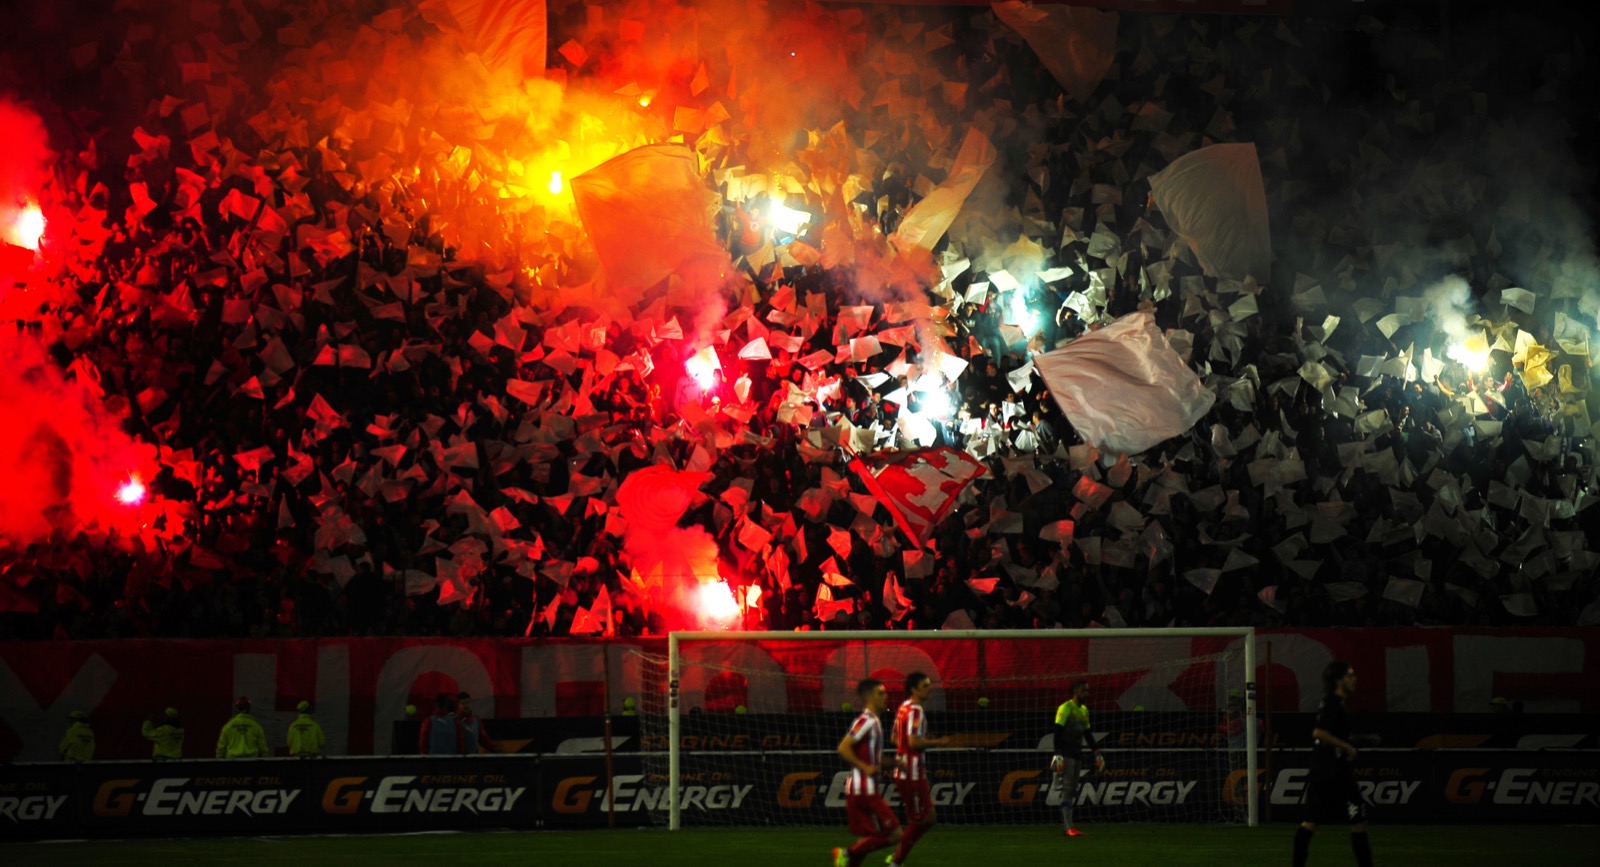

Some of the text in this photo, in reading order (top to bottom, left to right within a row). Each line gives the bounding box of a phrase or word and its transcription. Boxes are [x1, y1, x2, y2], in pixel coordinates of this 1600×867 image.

[762, 734, 809, 749] OIL
[195, 776, 282, 786] ENGINE OIL
[421, 773, 508, 784] ENGINE OIL
[648, 771, 706, 782] ENINE
[1444, 768, 1600, 809] G-ENER
